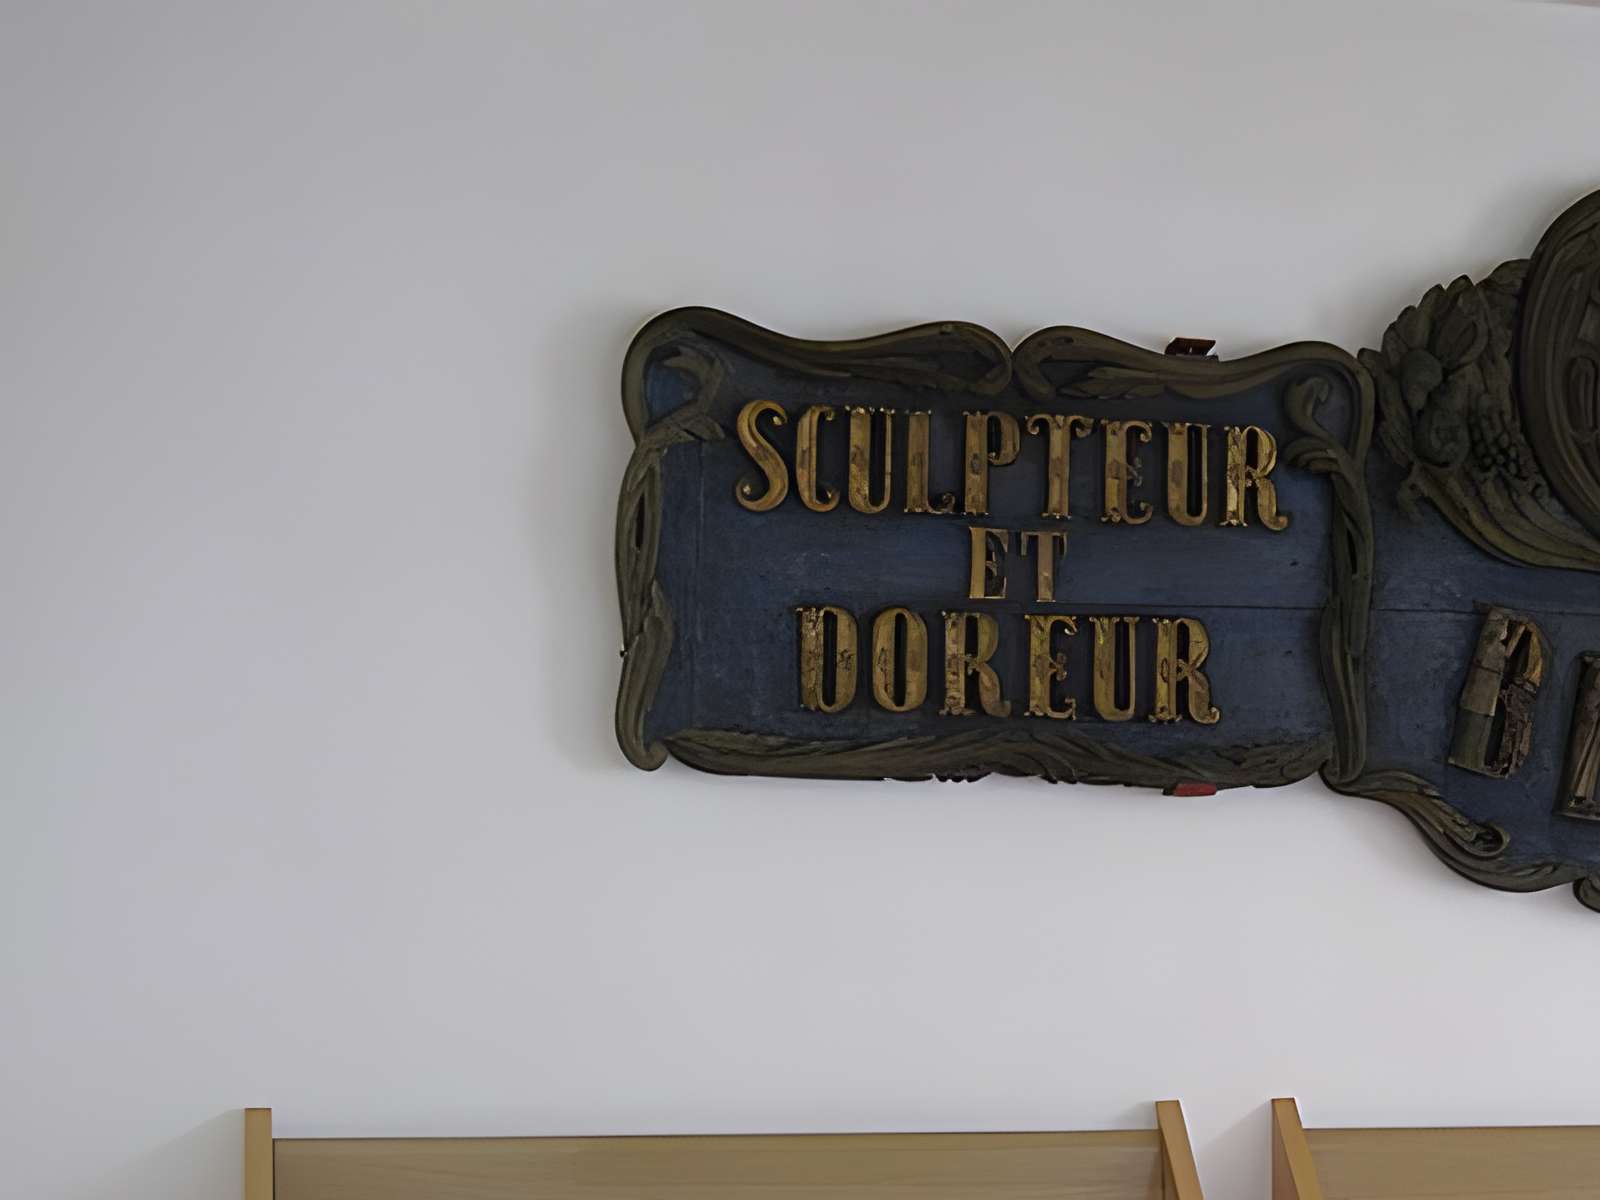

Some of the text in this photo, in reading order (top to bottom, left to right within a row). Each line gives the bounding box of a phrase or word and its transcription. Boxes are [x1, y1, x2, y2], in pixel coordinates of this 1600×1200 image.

[735, 400, 1289, 532] SCULPTEUR
[969, 526, 1068, 602] ET
[797, 606, 1221, 726] DOREUR
